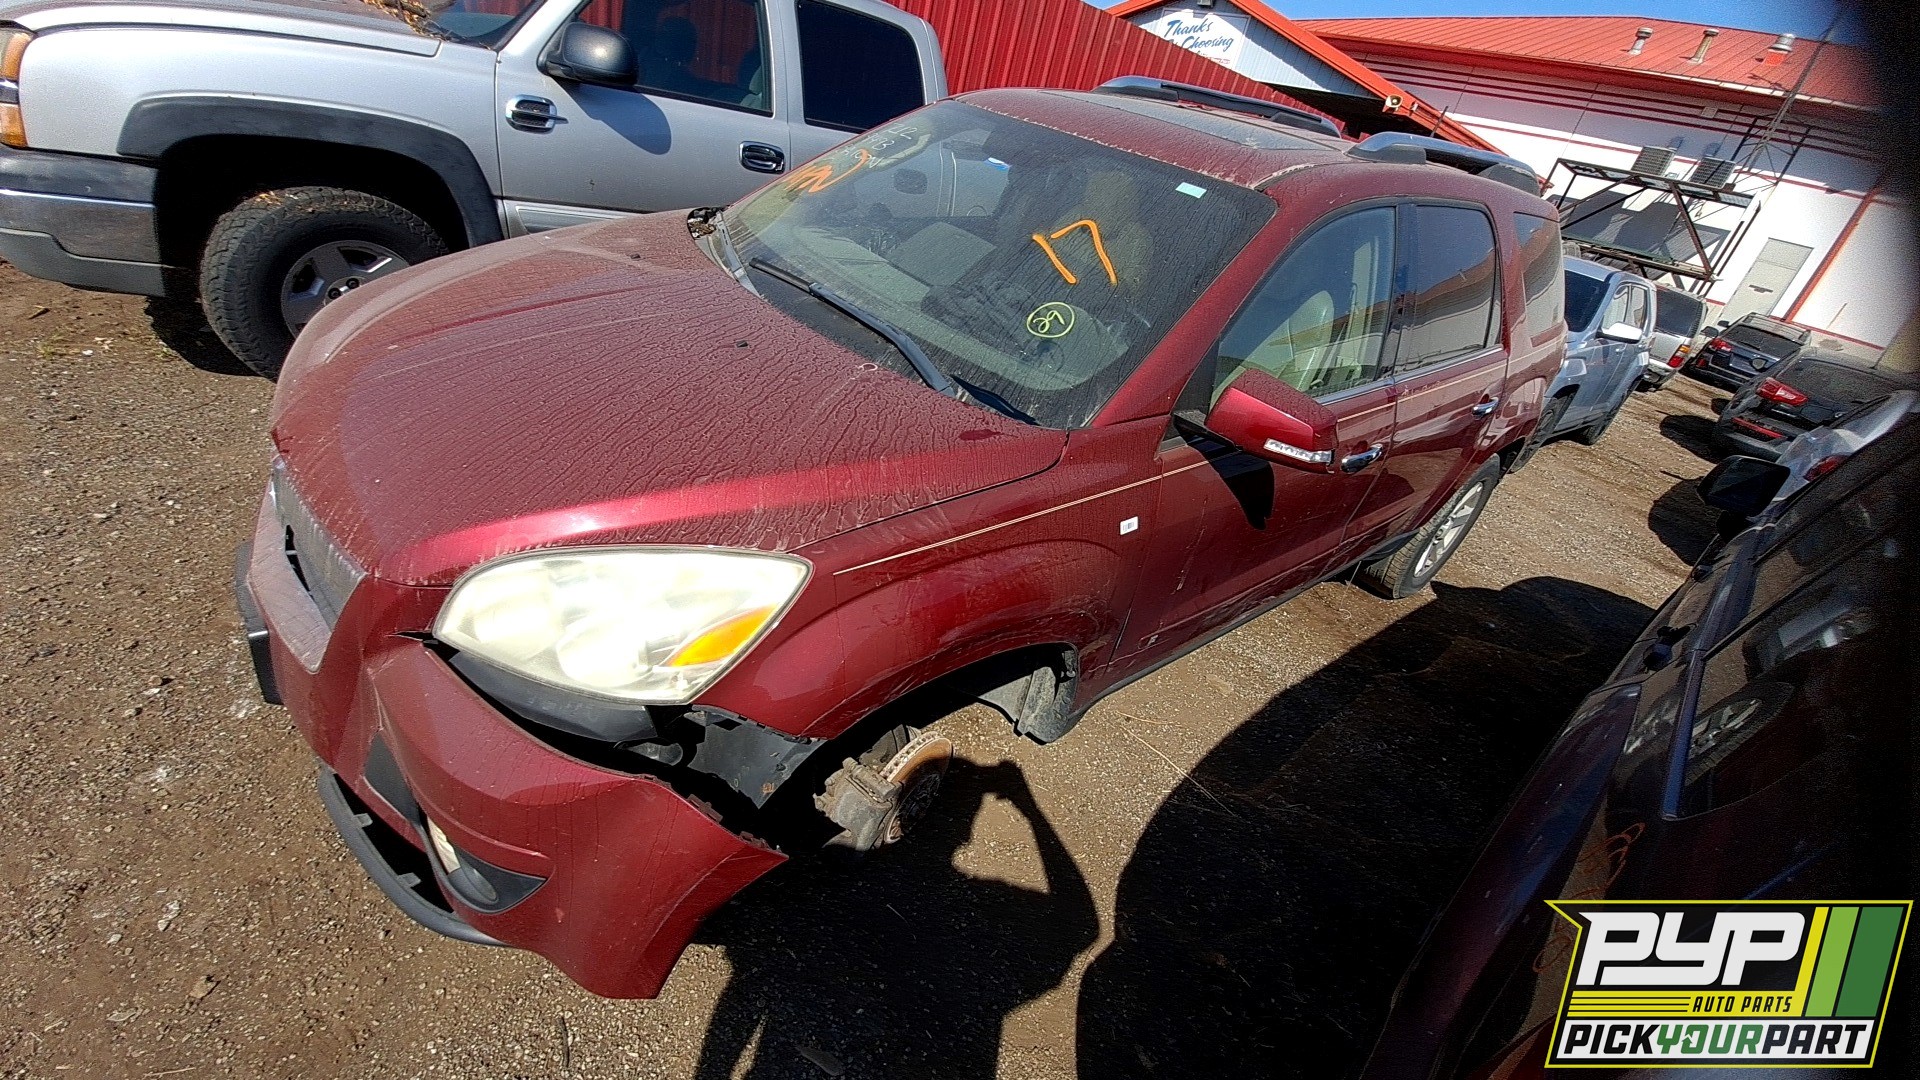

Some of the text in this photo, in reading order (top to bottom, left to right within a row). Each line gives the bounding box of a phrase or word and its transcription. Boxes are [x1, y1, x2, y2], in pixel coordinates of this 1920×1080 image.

[1164, 18, 1213, 37] Thanks
[1181, 35, 1234, 52] Choosing
[1032, 219, 1118, 286] 17
